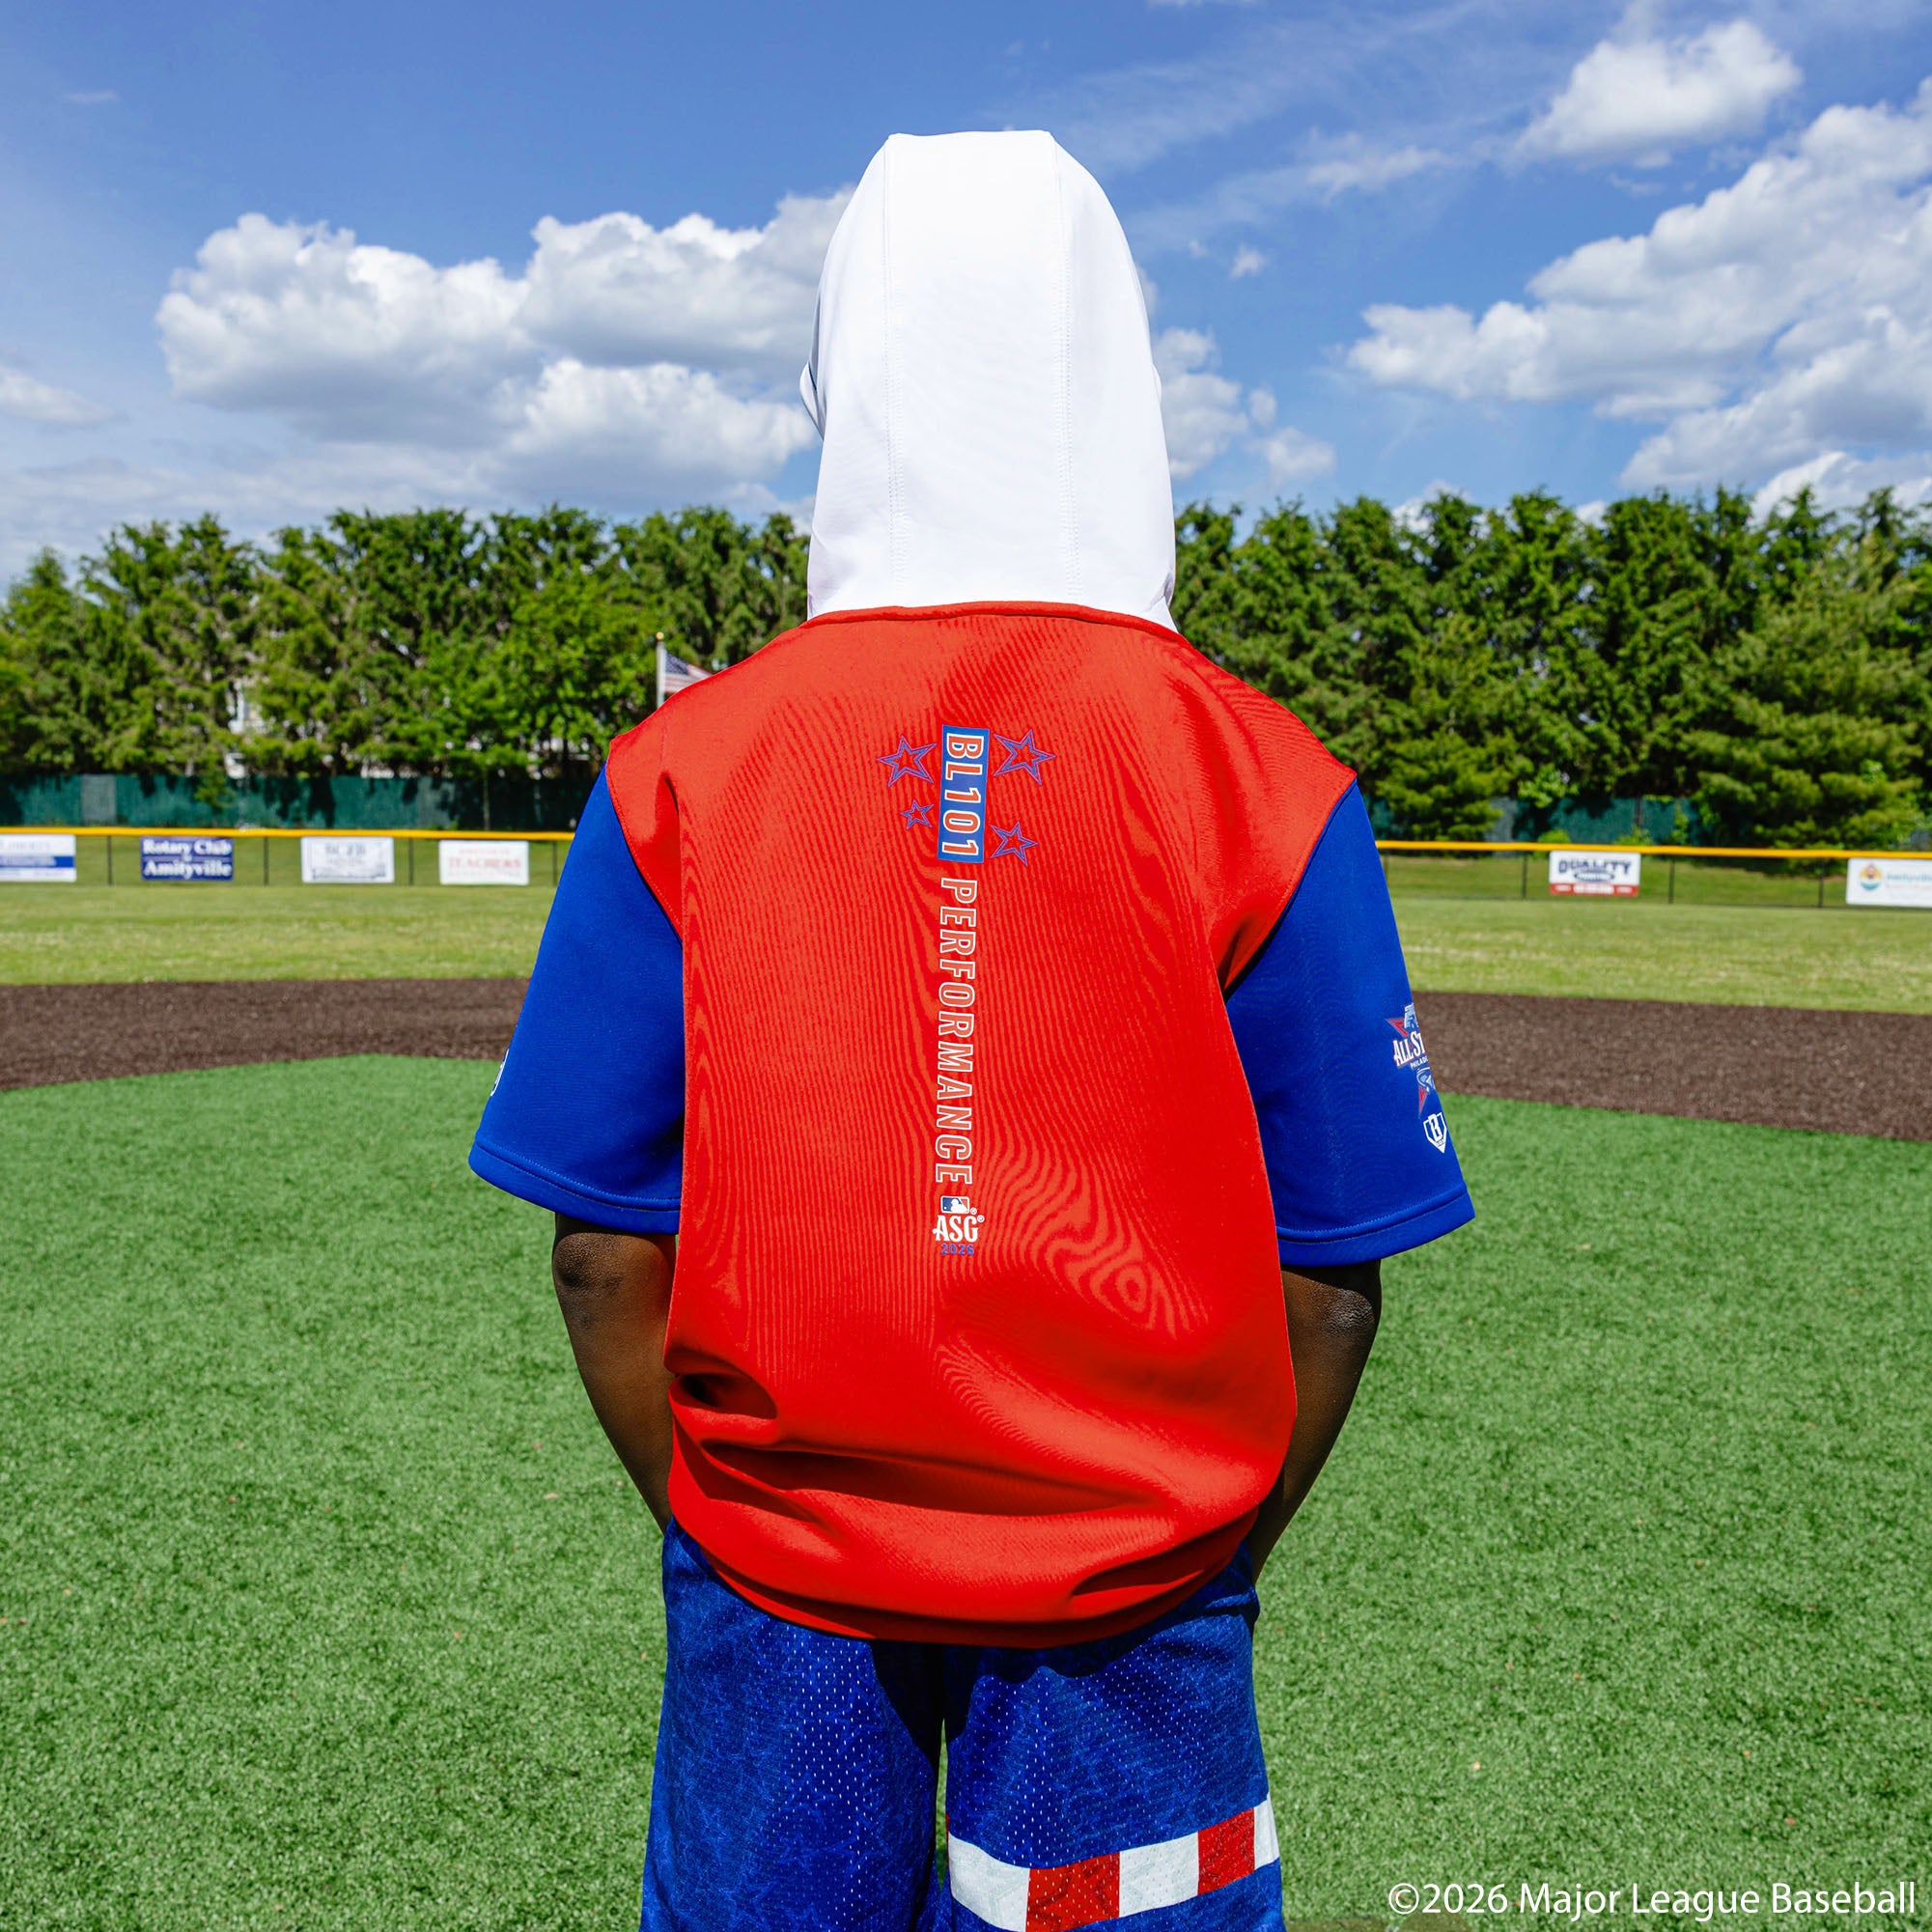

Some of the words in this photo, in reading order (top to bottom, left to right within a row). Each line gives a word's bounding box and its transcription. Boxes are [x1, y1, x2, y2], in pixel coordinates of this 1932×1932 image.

[942, 733, 985, 856] BL101
[143, 839, 192, 856] Rotary
[194, 839, 232, 855] Club
[143, 858, 233, 880] Amityville
[1557, 858, 1633, 875] QUALITY
[935, 877, 978, 1185] PERFORMANCE
[932, 1214, 979, 1243] ASG
[940, 1243, 975, 1256] 2026
